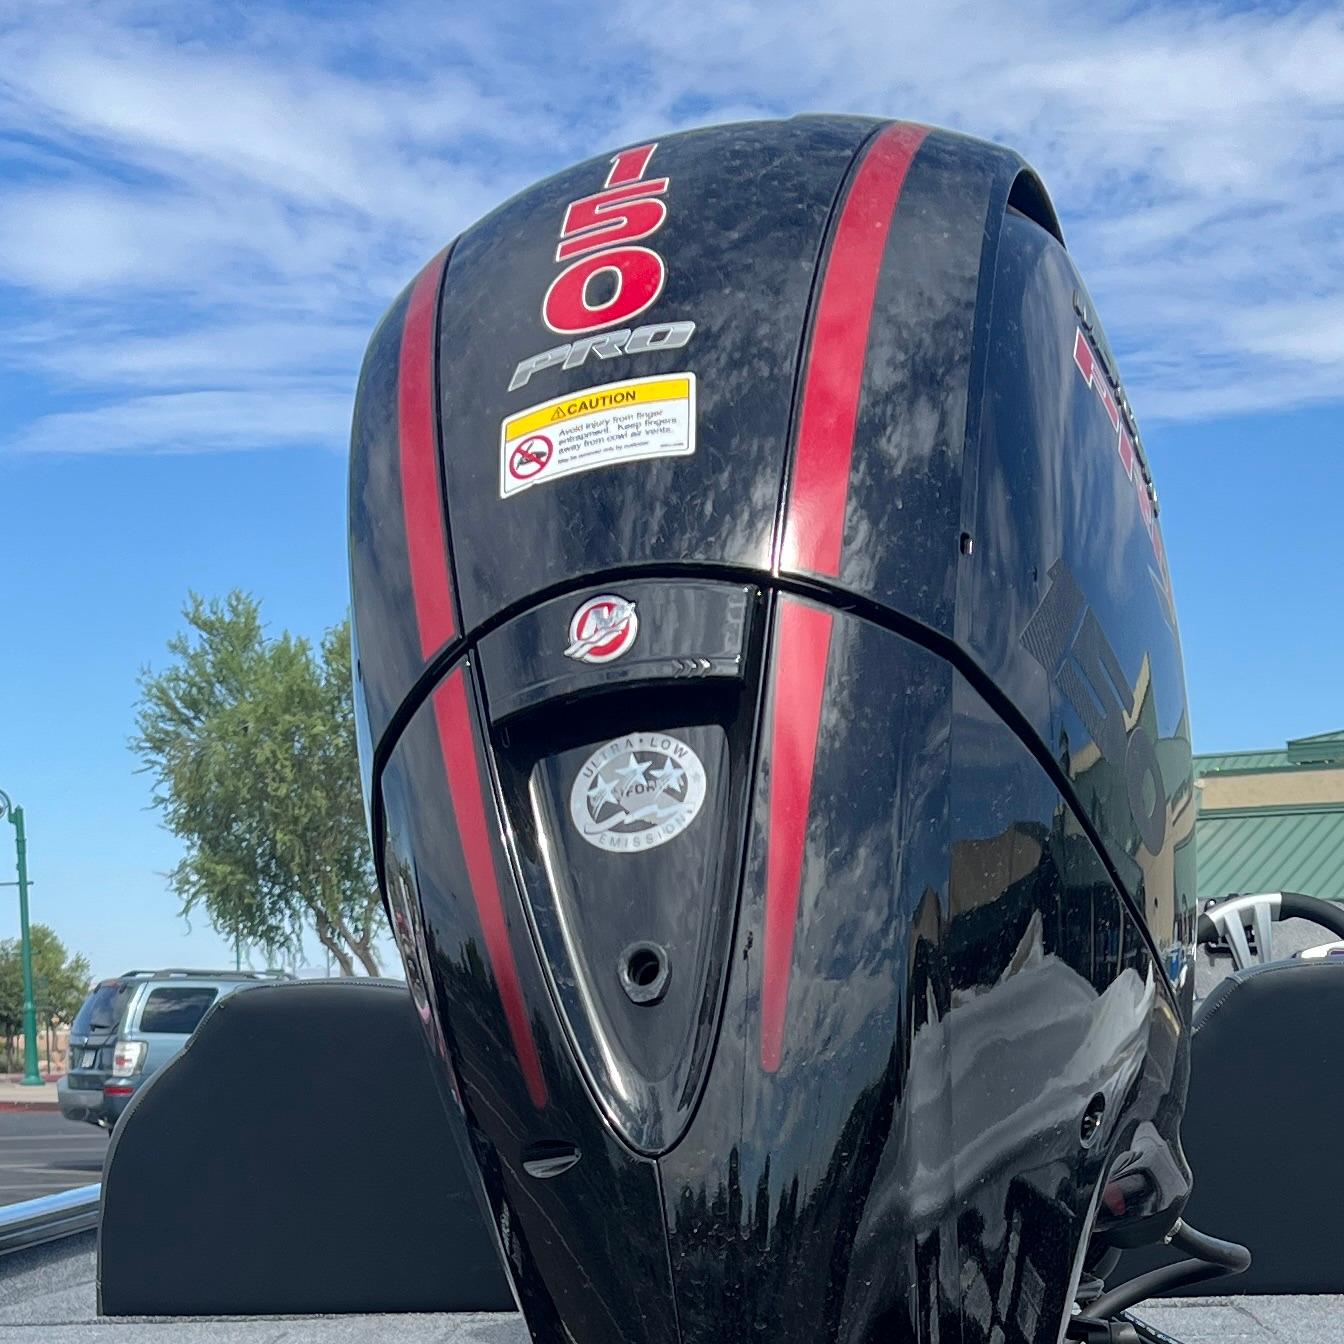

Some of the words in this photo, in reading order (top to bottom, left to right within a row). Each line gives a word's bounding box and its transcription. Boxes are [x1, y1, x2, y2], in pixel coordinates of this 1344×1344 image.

[542, 142, 669, 335] 150
[508, 320, 696, 391] PRO
[567, 390, 636, 415] CAUTION
[558, 425, 584, 437] Avoid
[586, 418, 610, 429] injury
[613, 415, 633, 424] from
[617, 422, 642, 432] Keep
[583, 738, 634, 779] ULTRA
[649, 737, 689, 759] LOW
